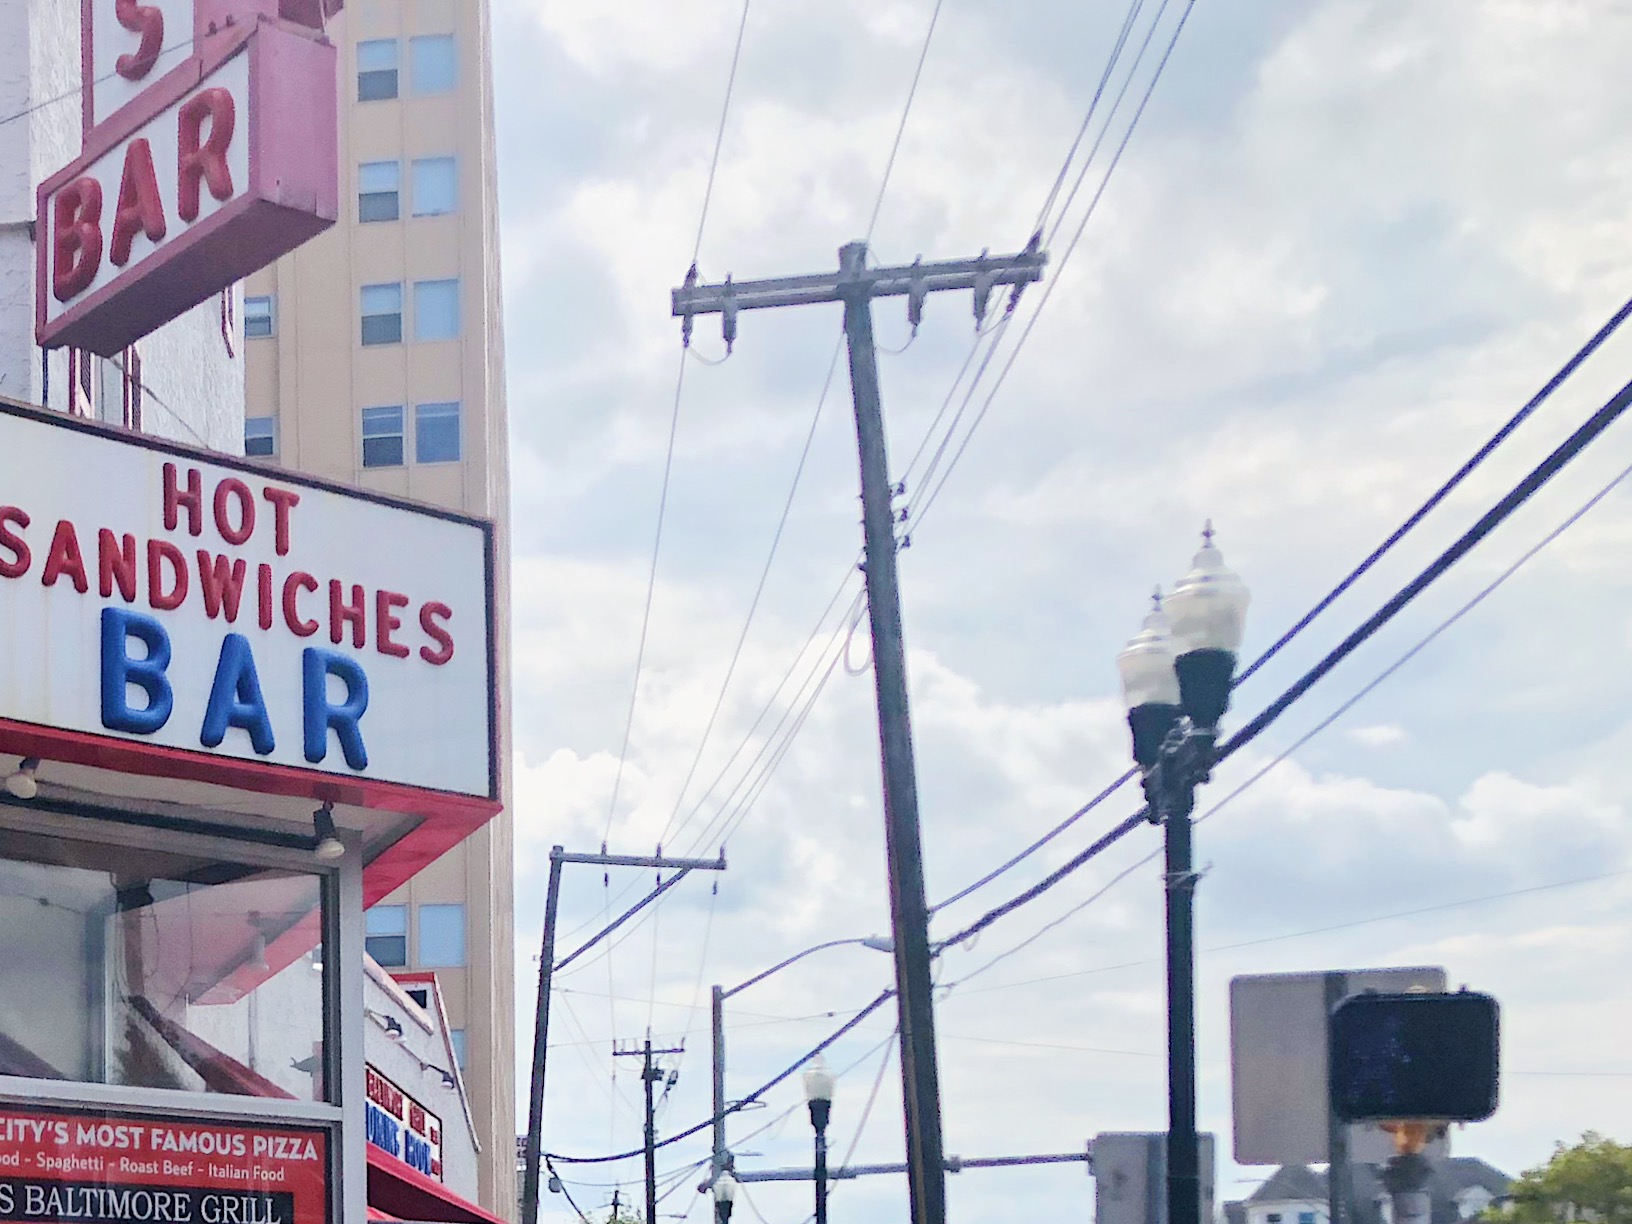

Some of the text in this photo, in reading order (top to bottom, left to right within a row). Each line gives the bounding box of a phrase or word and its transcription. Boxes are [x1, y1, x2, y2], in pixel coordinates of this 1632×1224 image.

[53, 87, 235, 302] BAR
[163, 462, 300, 556] HOT
[101, 606, 368, 770] BAR
[36, 1152, 104, 1172] Spaghetti
[120, 1157, 159, 1175] Roast
[163, 1161, 194, 1176] Beef
[208, 1163, 250, 1180] Italian
[253, 1166, 285, 1181] Food
[77, 1122, 144, 1150] MOST
[151, 1128, 246, 1156] FAMOUS
[253, 1135, 318, 1161] PIZZA
[24, 1184, 192, 1222] BALTIMORE
